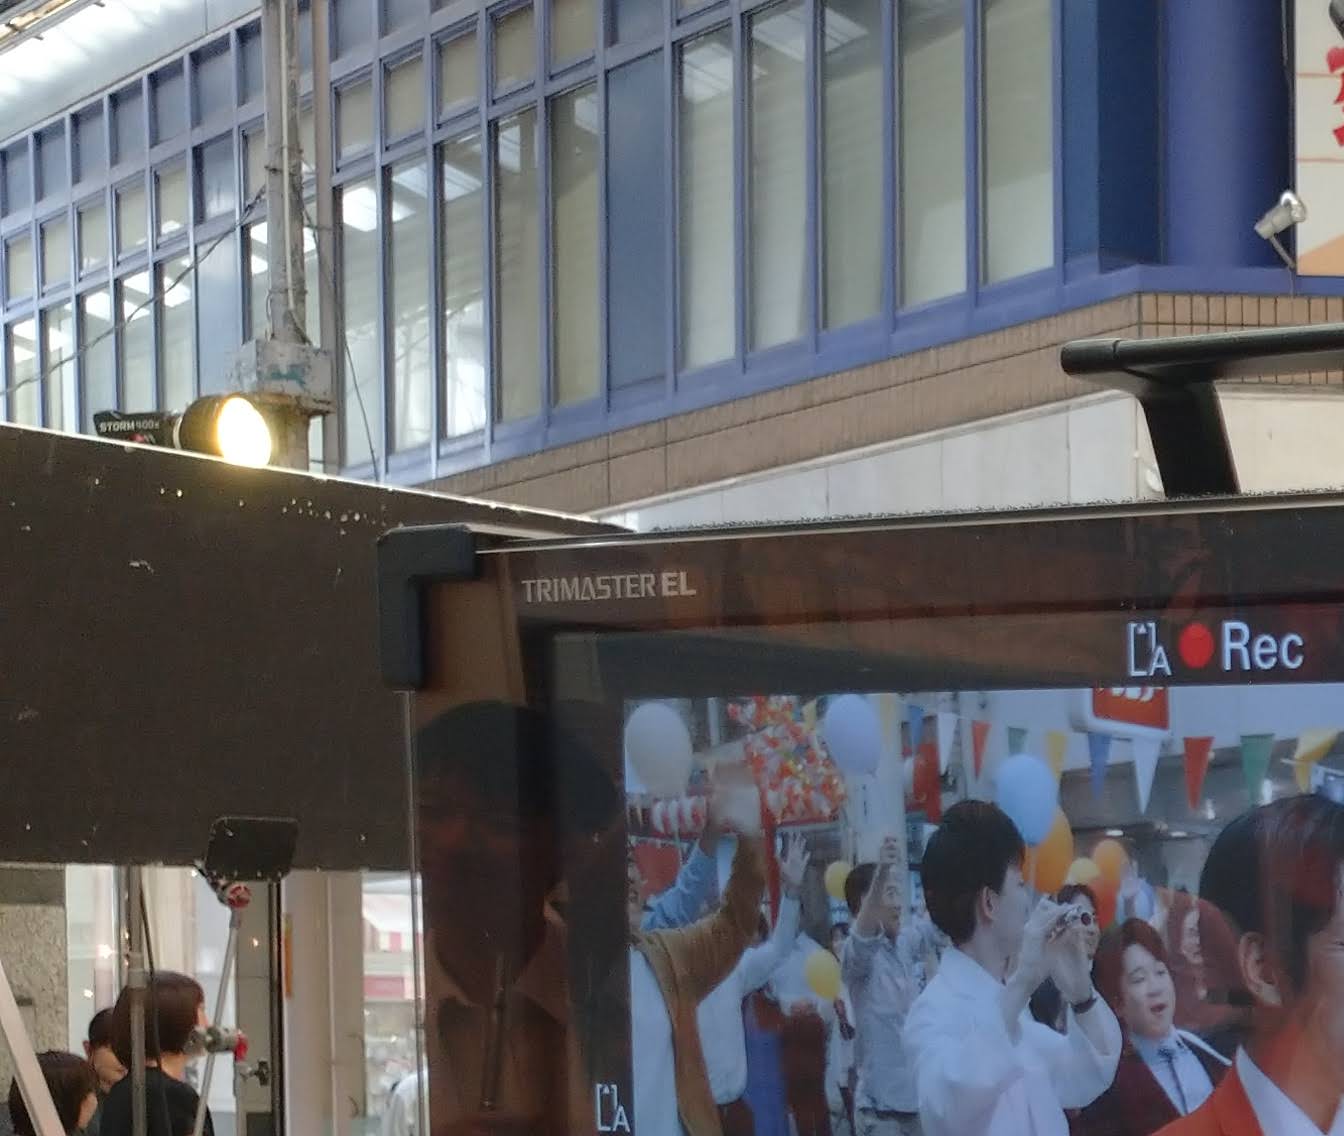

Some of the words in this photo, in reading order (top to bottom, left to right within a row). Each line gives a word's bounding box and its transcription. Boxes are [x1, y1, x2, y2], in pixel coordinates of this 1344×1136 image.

[521, 573, 657, 603] TRIMASTER
[661, 570, 697, 597] EL
[1222, 620, 1305, 671] Rec
